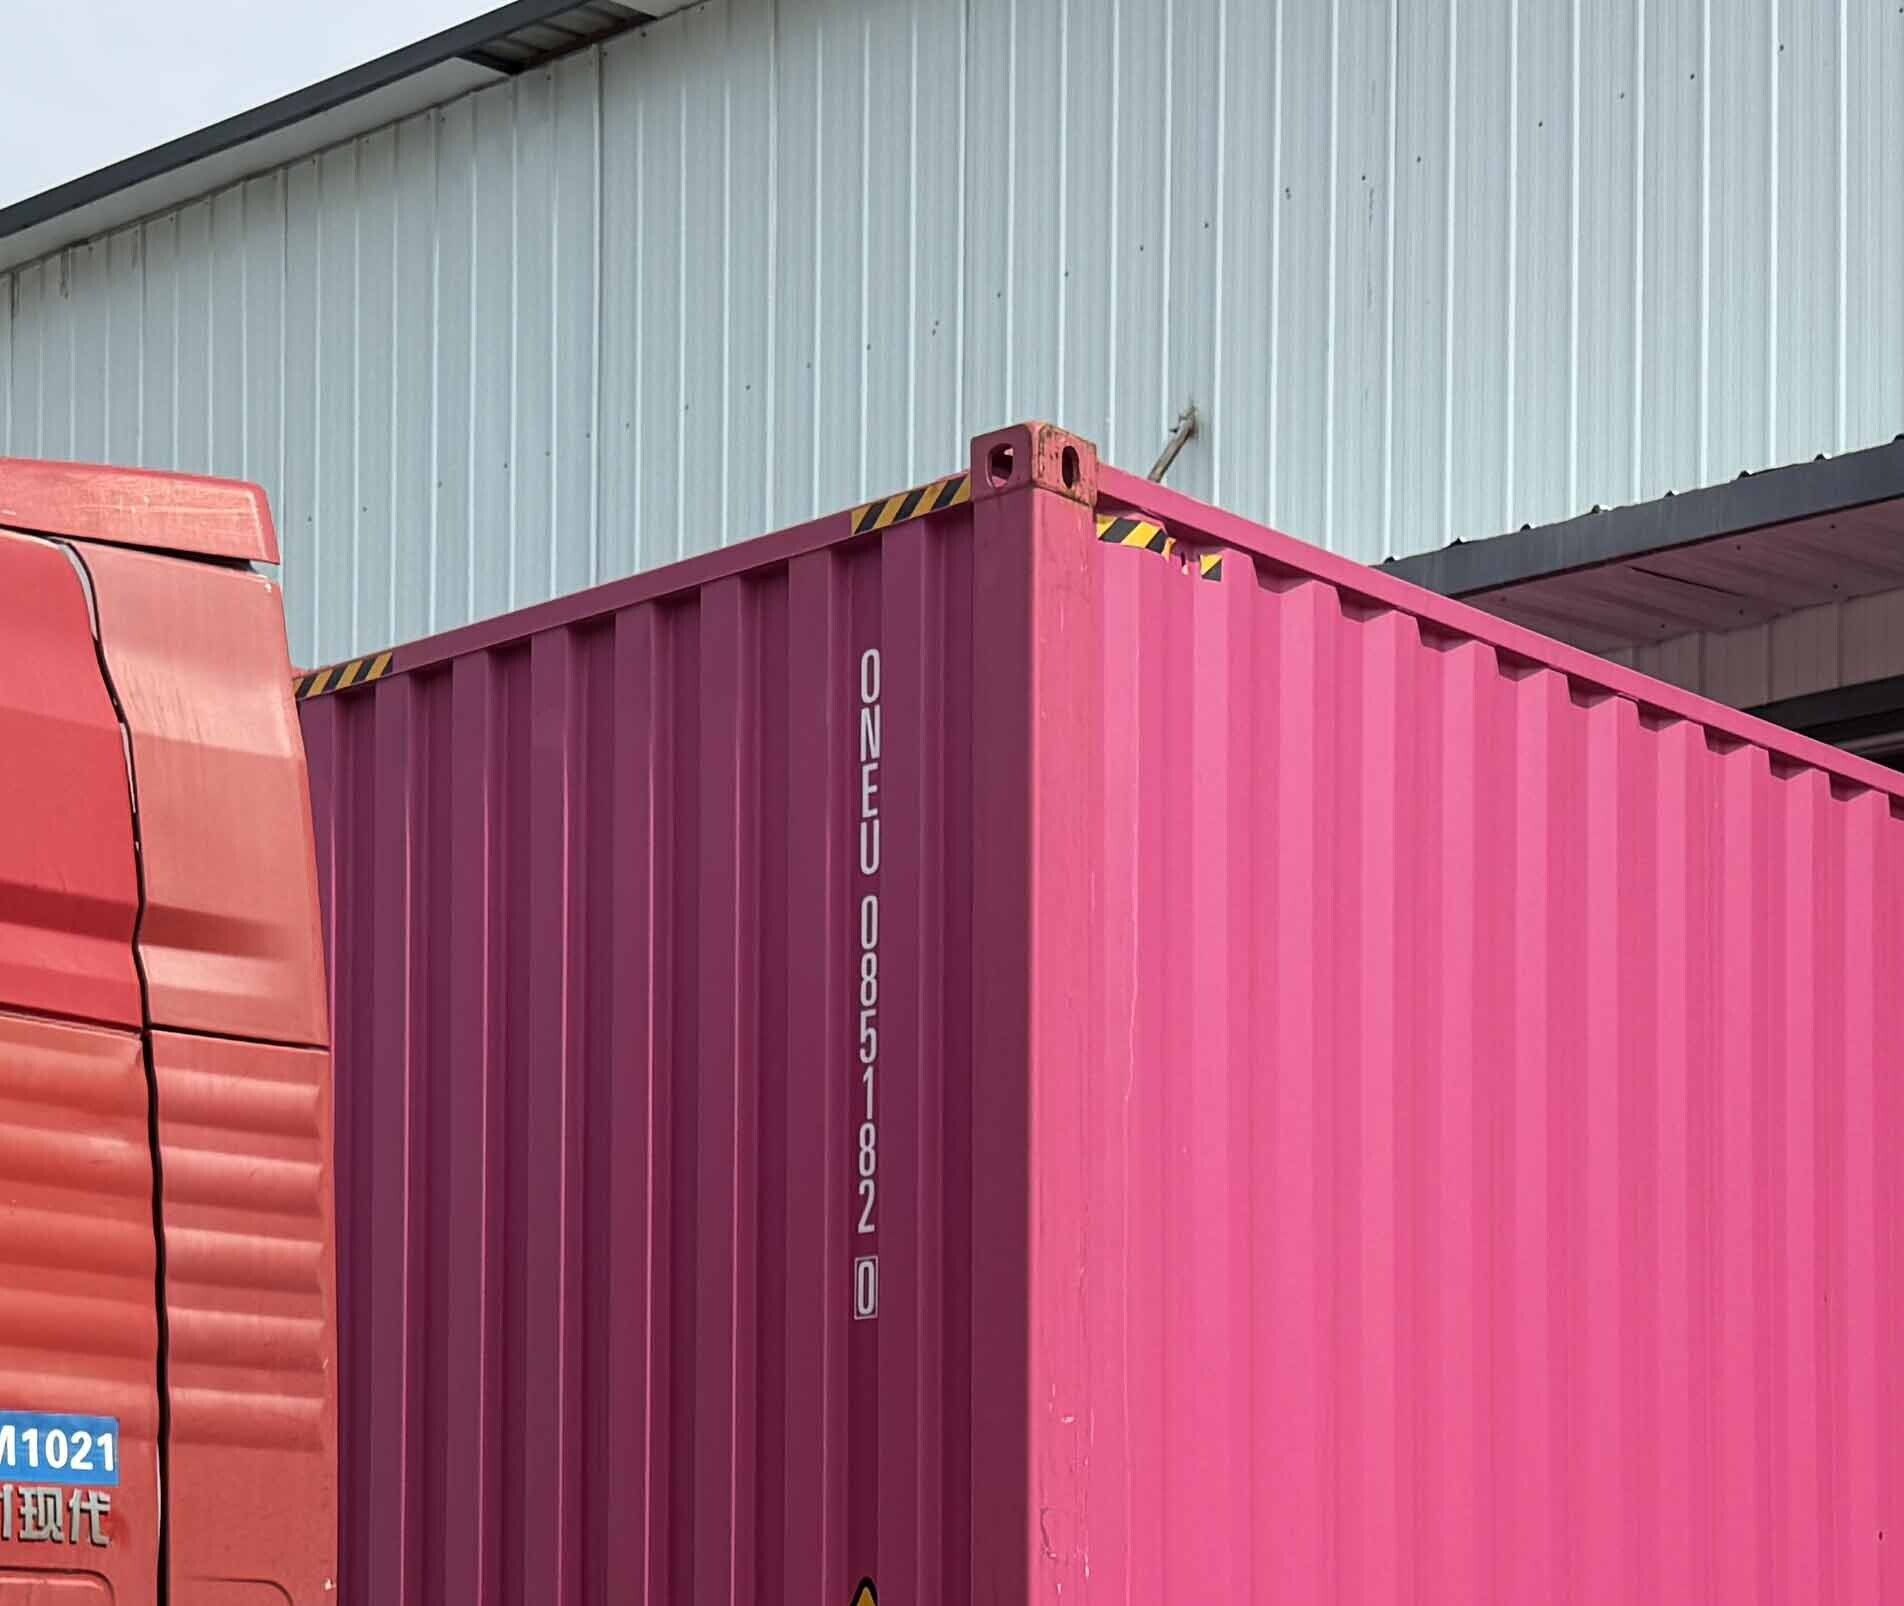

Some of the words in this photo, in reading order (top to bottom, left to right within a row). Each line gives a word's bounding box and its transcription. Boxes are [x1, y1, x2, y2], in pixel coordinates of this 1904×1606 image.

[859, 648, 881, 876] ONEU
[857, 894, 880, 1234] 085182
[855, 1258, 877, 1318] 0
